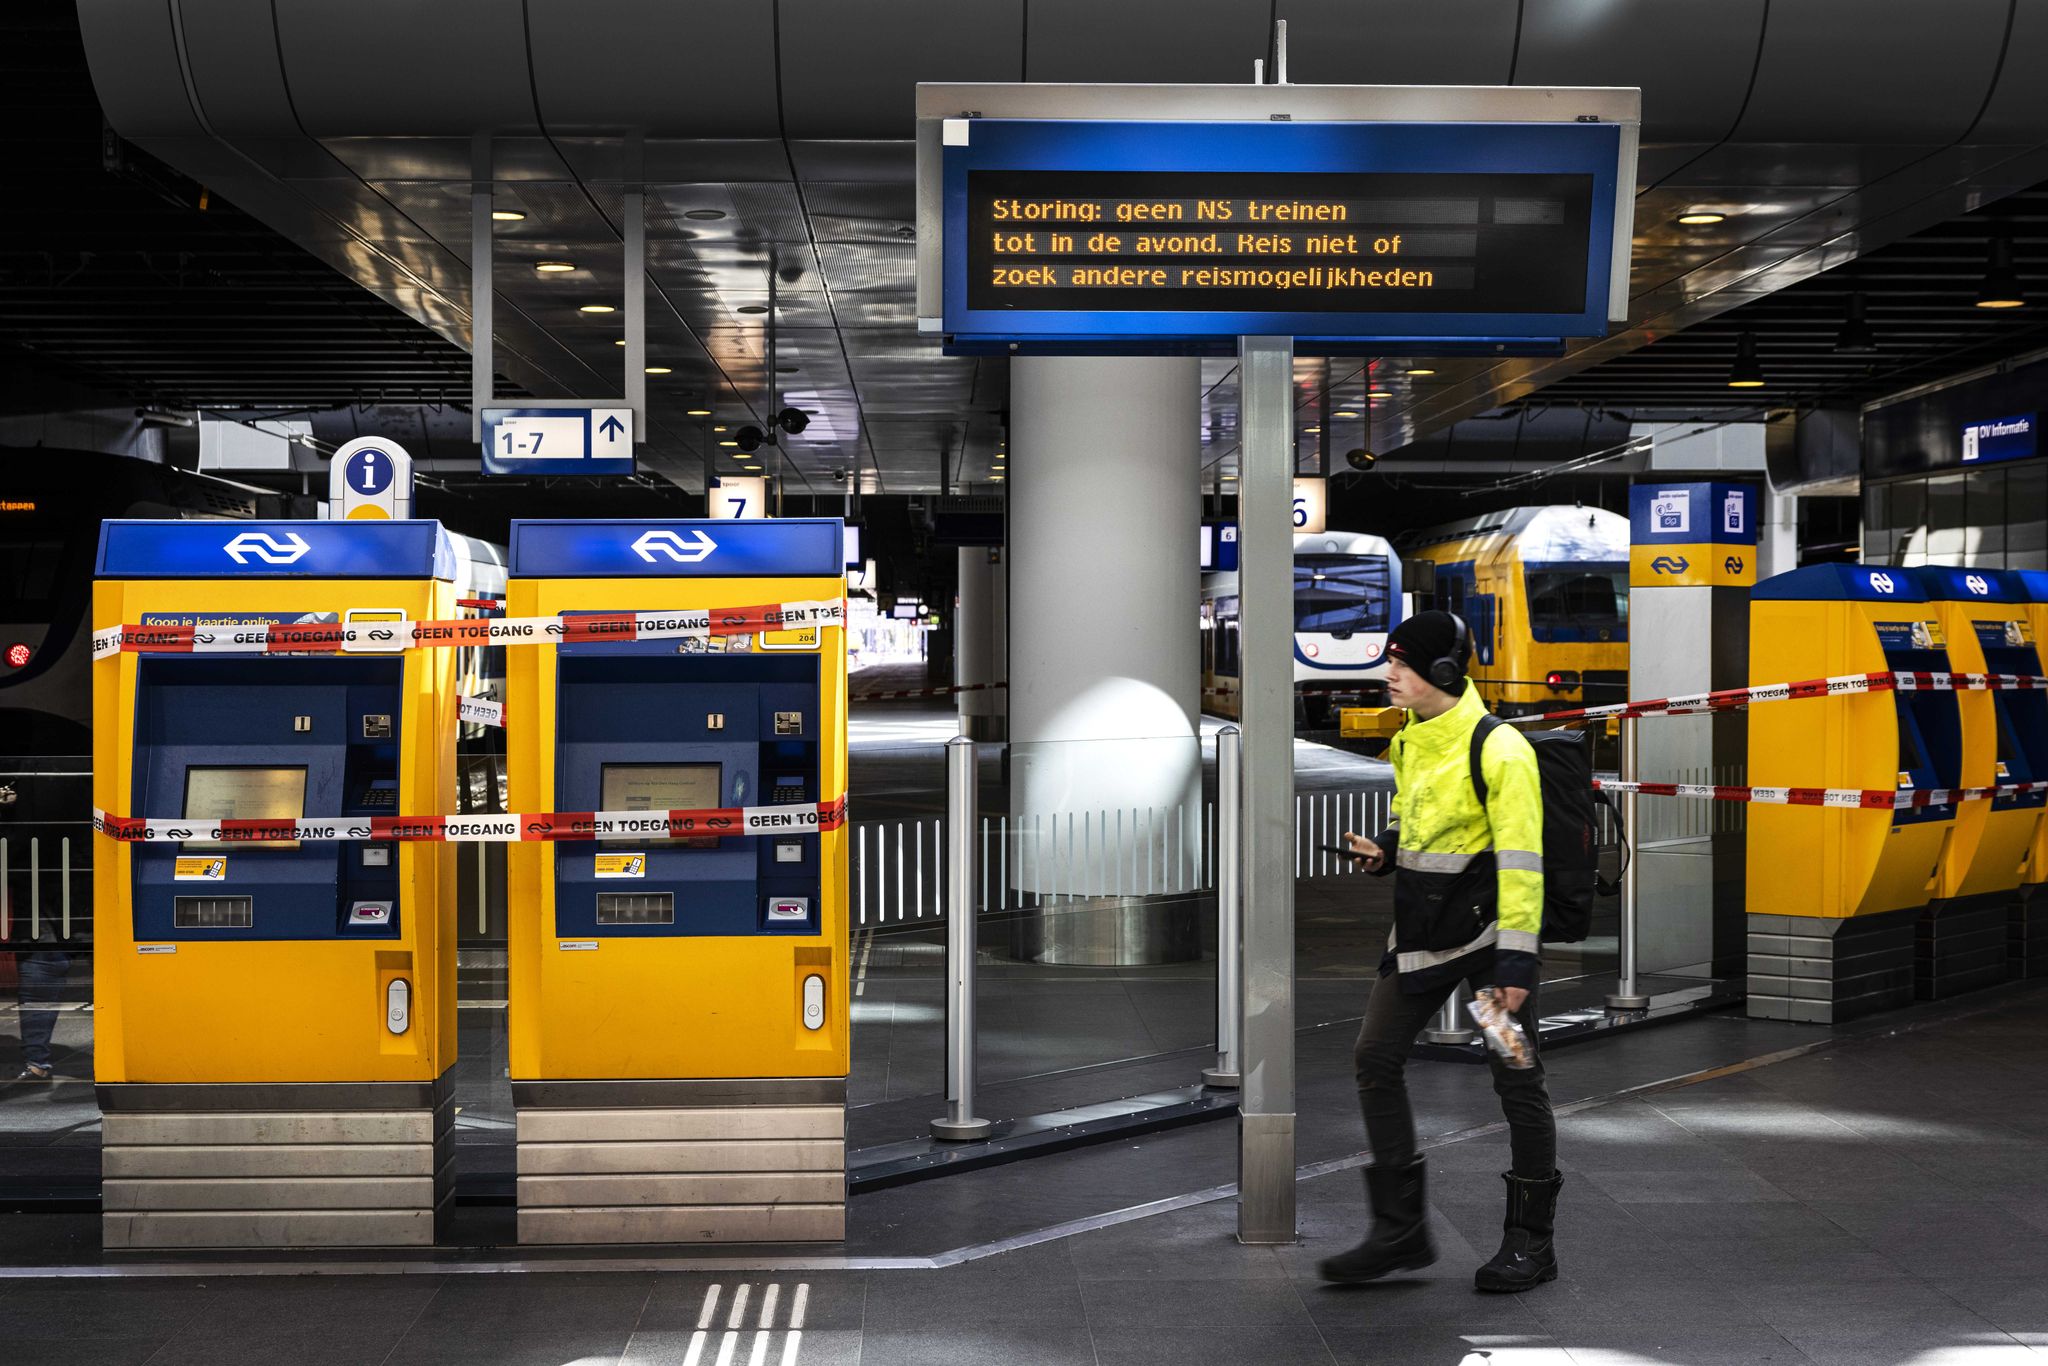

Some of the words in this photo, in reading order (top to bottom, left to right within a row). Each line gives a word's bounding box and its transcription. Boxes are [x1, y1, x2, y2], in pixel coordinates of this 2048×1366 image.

[993, 200, 1101, 222] Storing:
[1116, 202, 1182, 222] geen
[1197, 200, 1233, 220] NS
[1248, 201, 1347, 221] treinen
[993, 233, 1036, 252] tot
[1052, 233, 1073, 252] in
[1087, 233, 1121, 252] de
[1136, 234, 1223, 253] avond.
[1238, 234, 1292, 254] Reis
[1306, 234, 1358, 254] niet
[1373, 235, 1401, 254] of
[992, 266, 1057, 285] zoek
[1072, 266, 1167, 286] andere
[1181, 267, 1433, 290] reismogelijkheden
[1980, 424, 1991, 438] OV
[1992, 418, 2029, 437] Informatie
[502, 432, 544, 455] 1-7
[728, 498, 746, 518] 7
[1225, 531, 1232, 540] 6
[764, 609, 806, 624] GEEN
[411, 626, 453, 640] GEEN
[459, 624, 534, 638] TOEGANG
[588, 621, 630, 634] GEEN
[636, 617, 711, 631] TOEGANG
[111, 632, 179, 647] TOEGANG
[233, 633, 276, 644] GEEN
[282, 630, 357, 643] TOEGANG
[571, 820, 613, 833] GEEN
[618, 818, 695, 832] TOEGANG
[750, 813, 793, 827] GEEN
[211, 827, 254, 839] GEEN
[260, 827, 335, 839] TOEGANG
[391, 825, 433, 837] GEEN
[438, 823, 515, 836] TOEGANG
